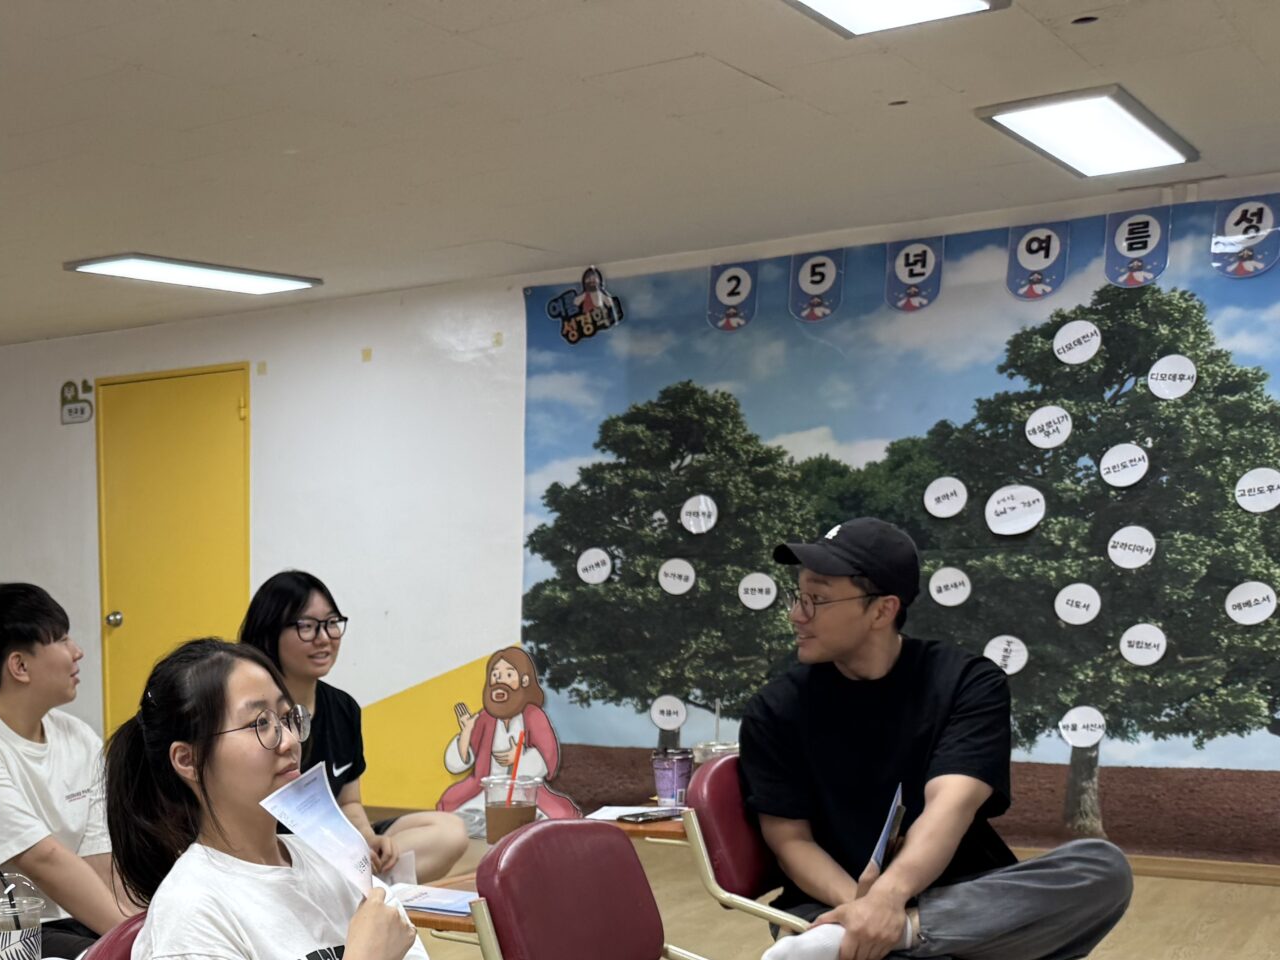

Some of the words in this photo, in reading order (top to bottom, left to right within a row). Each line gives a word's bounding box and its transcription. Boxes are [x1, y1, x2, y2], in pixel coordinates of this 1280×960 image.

[726, 274, 741, 298] 2
[808, 262, 826, 285] 5
[904, 249, 927, 278] 년
[1025, 234, 1053, 259] 여
[1124, 220, 1152, 251] 름
[1056, 329, 1099, 356] 디모데전서
[1149, 372, 1195, 383] 디모데후서
[1027, 414, 1069, 436] 데살로니가
[1043, 426, 1061, 439] 후서
[1102, 454, 1146, 476] 고린도전서
[1110, 540, 1153, 556] 갈라디아서
[1065, 598, 1091, 611] 디도서
[1231, 594, 1271, 611] 에베소서
[1126, 640, 1161, 652] 빌립보서
